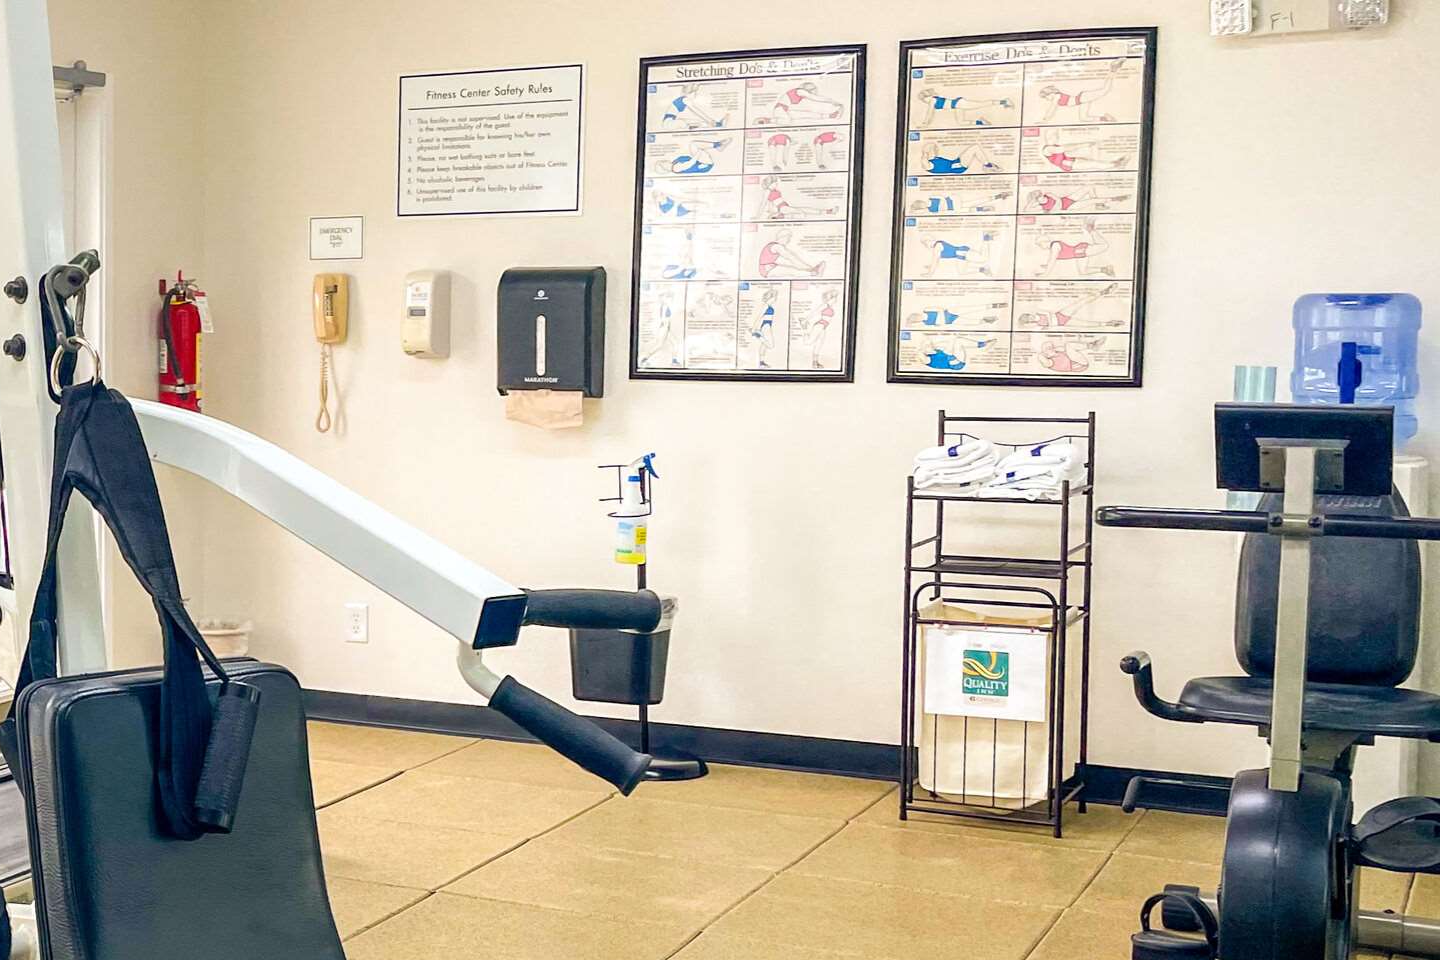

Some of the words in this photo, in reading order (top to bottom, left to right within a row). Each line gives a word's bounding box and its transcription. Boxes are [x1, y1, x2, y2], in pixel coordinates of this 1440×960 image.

[676, 65, 734, 79] Stretching
[426, 90, 457, 101] Fitness
[460, 88, 490, 99] Center
[494, 85, 524, 97] Safety
[528, 84, 553, 95] Rules
[964, 678, 1008, 690] QUALITY
